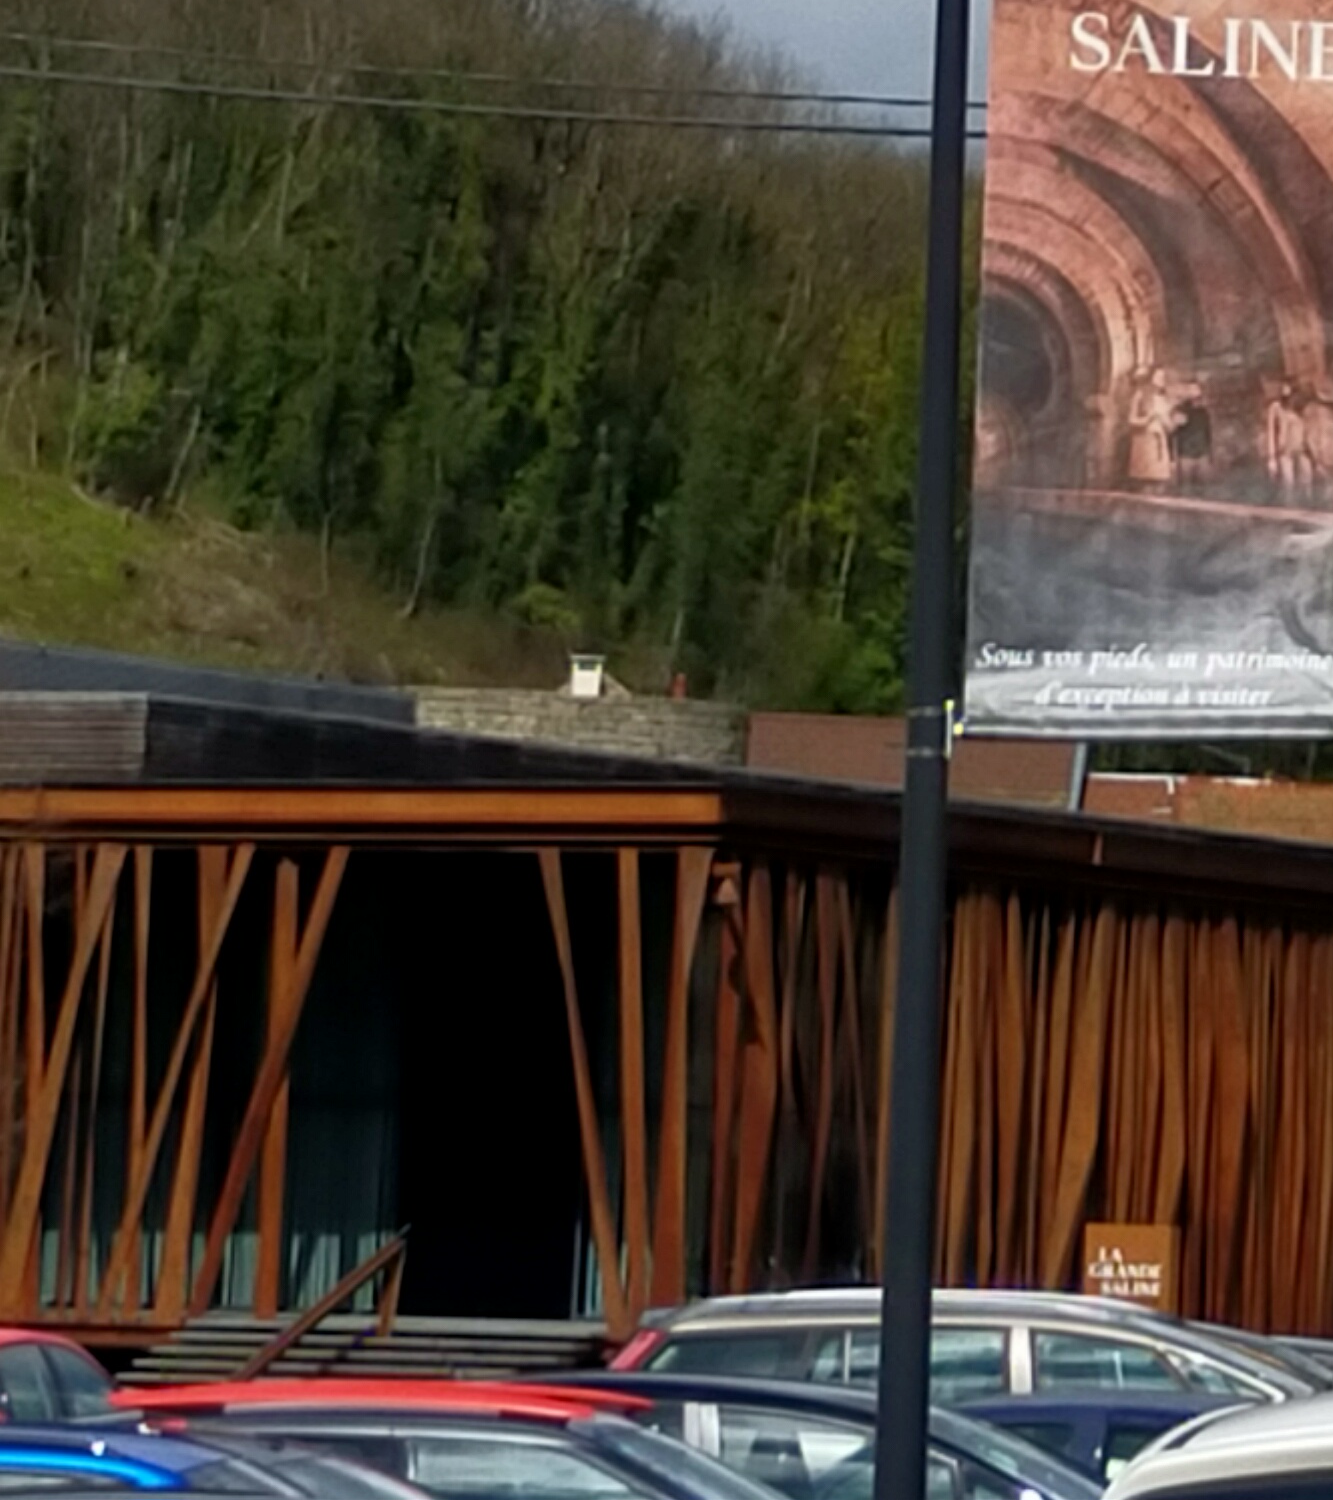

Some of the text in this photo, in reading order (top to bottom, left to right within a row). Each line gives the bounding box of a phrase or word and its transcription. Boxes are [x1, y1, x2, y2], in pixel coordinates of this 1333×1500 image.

[975, 642, 1034, 669] Sous
[1042, 649, 1084, 668] vos
[1088, 642, 1155, 676] pieds,
[1166, 651, 1199, 669] un
[1033, 680, 1169, 713] d'exception
[1197, 683, 1274, 706] visiter
[1098, 1246, 1123, 1262] LA
[1087, 1262, 1162, 1279] GRANDE
[1101, 1280, 1162, 1298] SALINE
